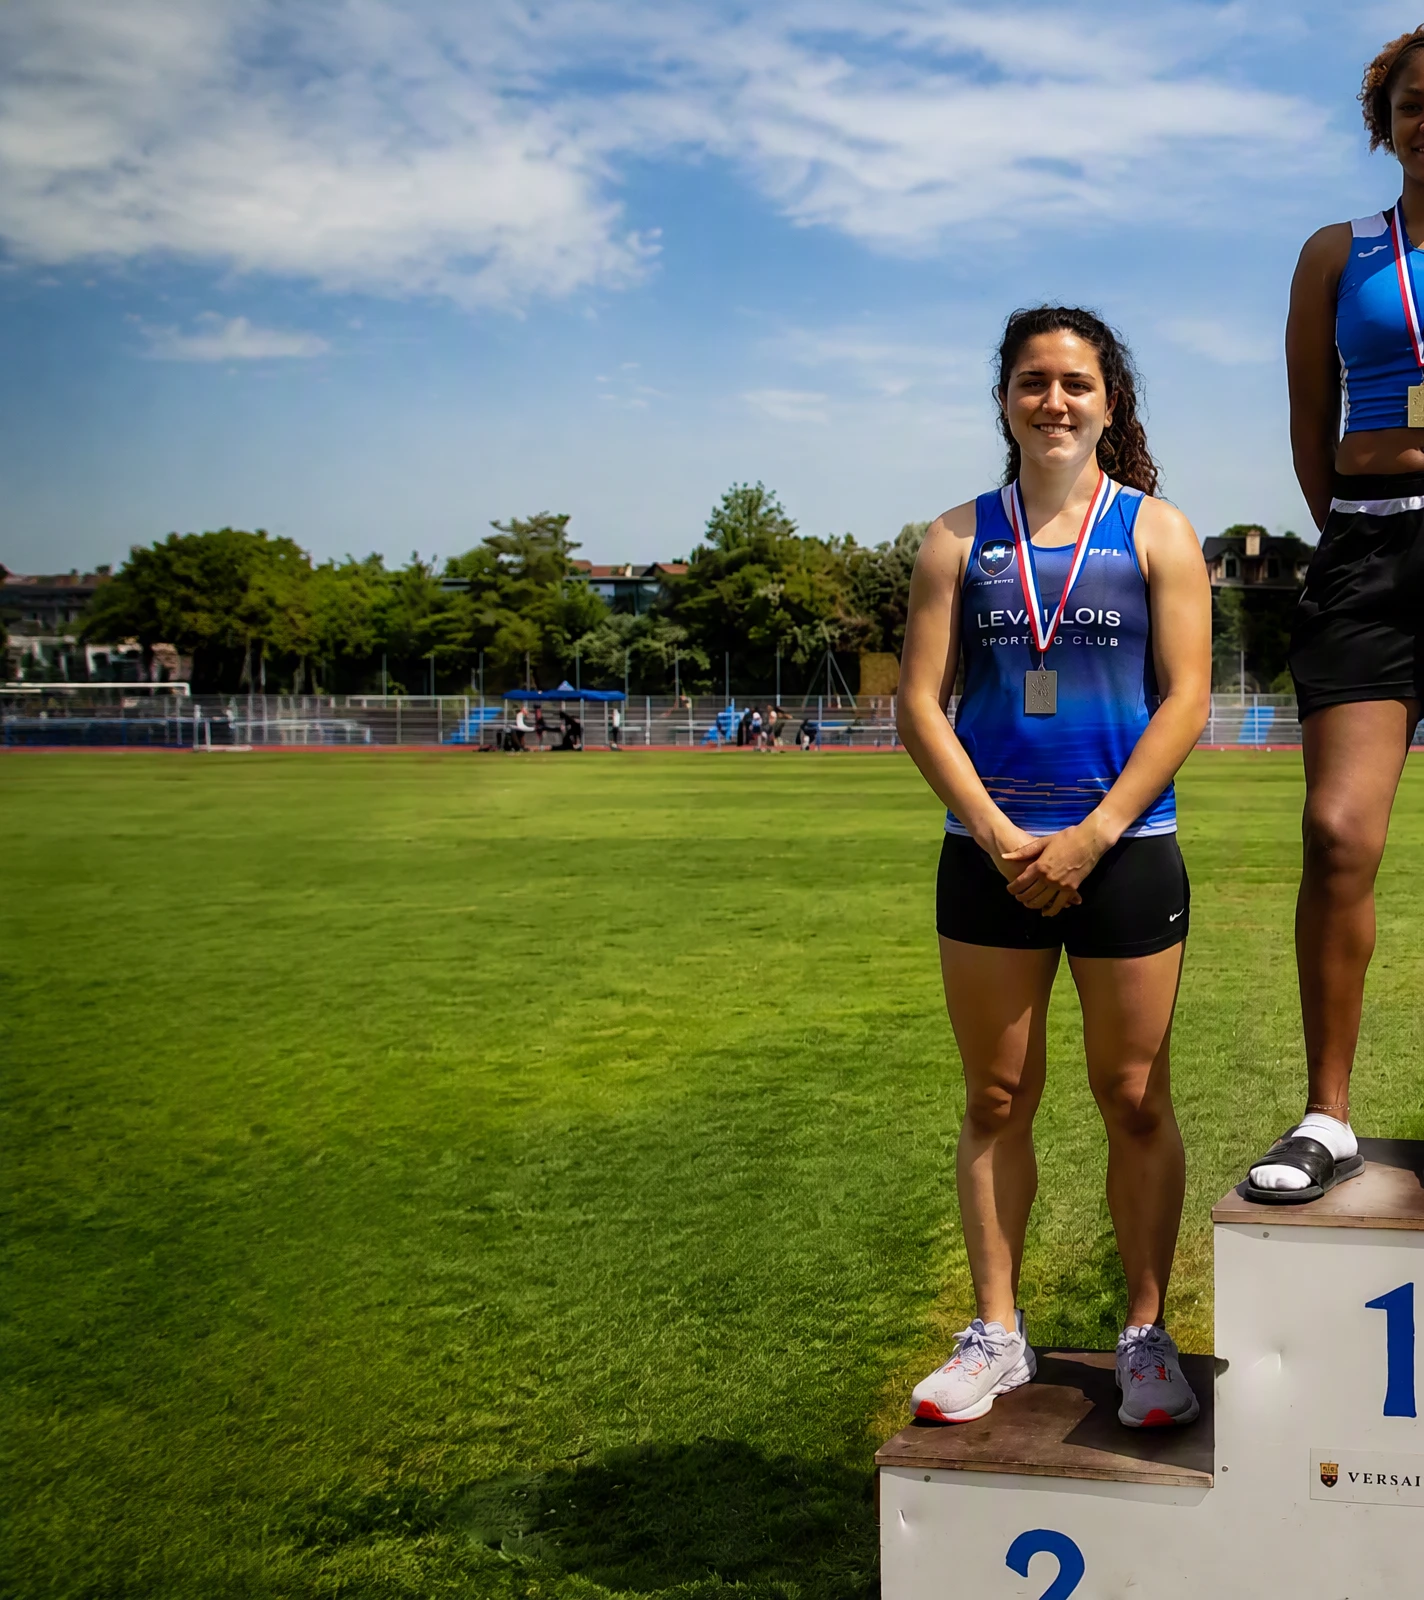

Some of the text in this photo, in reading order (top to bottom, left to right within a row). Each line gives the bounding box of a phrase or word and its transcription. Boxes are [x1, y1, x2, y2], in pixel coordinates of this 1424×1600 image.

[1088, 548, 1122, 557] PFL
[981, 636, 1119, 647] SPORTG CLUB
[1364, 1282, 1417, 1418] 1
[1005, 1528, 1085, 1600] 2
